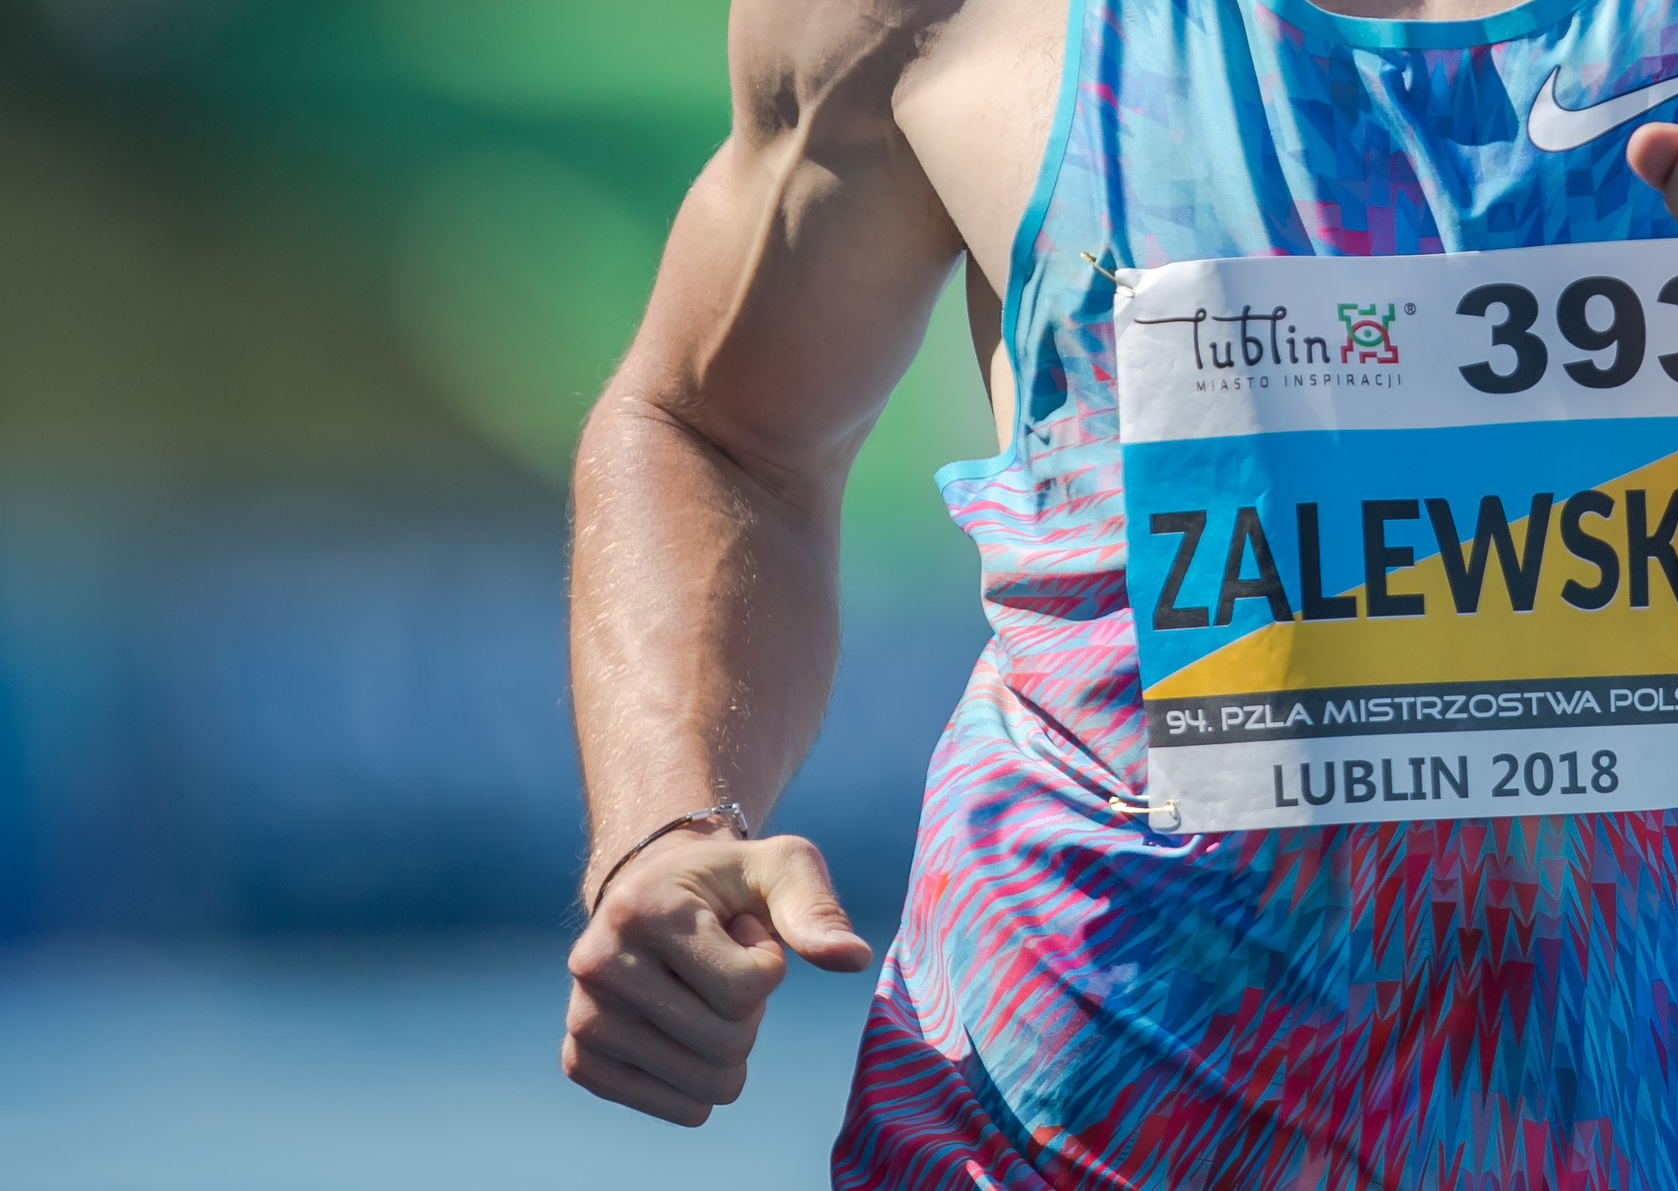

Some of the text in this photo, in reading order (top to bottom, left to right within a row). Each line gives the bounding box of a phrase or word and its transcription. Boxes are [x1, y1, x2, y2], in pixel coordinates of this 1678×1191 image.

[1196, 373, 1402, 392] MIASTO INSPIRACJI
[1166, 705, 1214, 734] 94.
[1221, 702, 1314, 731] PZLA
[1322, 689, 1602, 724] MISTRZOSTWA
[1273, 750, 1620, 808] LUBLIN 2018
